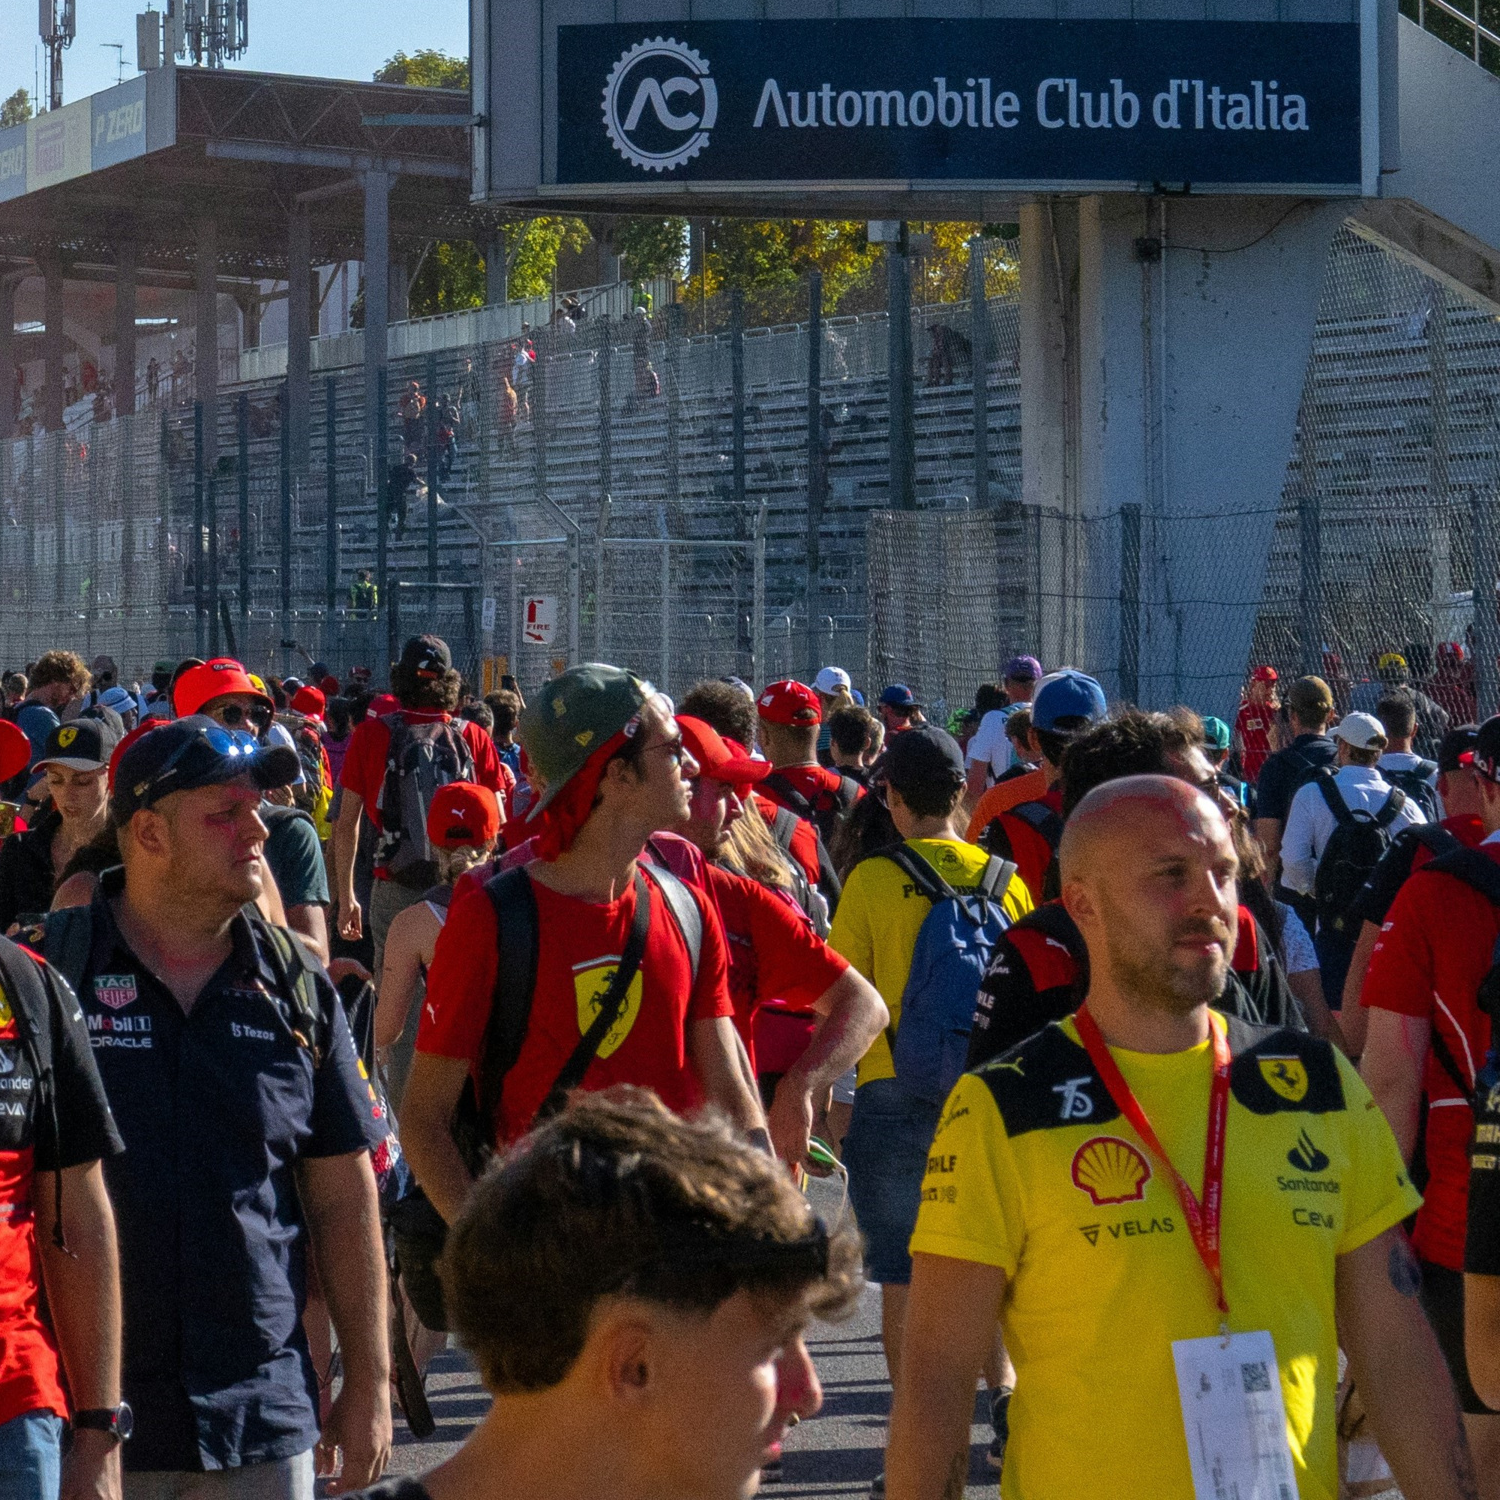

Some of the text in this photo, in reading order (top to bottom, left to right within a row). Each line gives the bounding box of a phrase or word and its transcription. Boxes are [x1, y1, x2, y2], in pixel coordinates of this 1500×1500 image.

[753, 77, 1309, 131] Automobile Club d'Italia
[107, 100, 144, 143] ZERO
[526, 623, 551, 631] FIRE
[94, 977, 132, 988] TAG
[88, 1014, 133, 1032] Mobil
[243, 1025, 275, 1041] Tezos
[89, 1036, 153, 1049] ORACLE
[1277, 1176, 1340, 1194] Santande
[1107, 1217, 1175, 1239] VELAS
